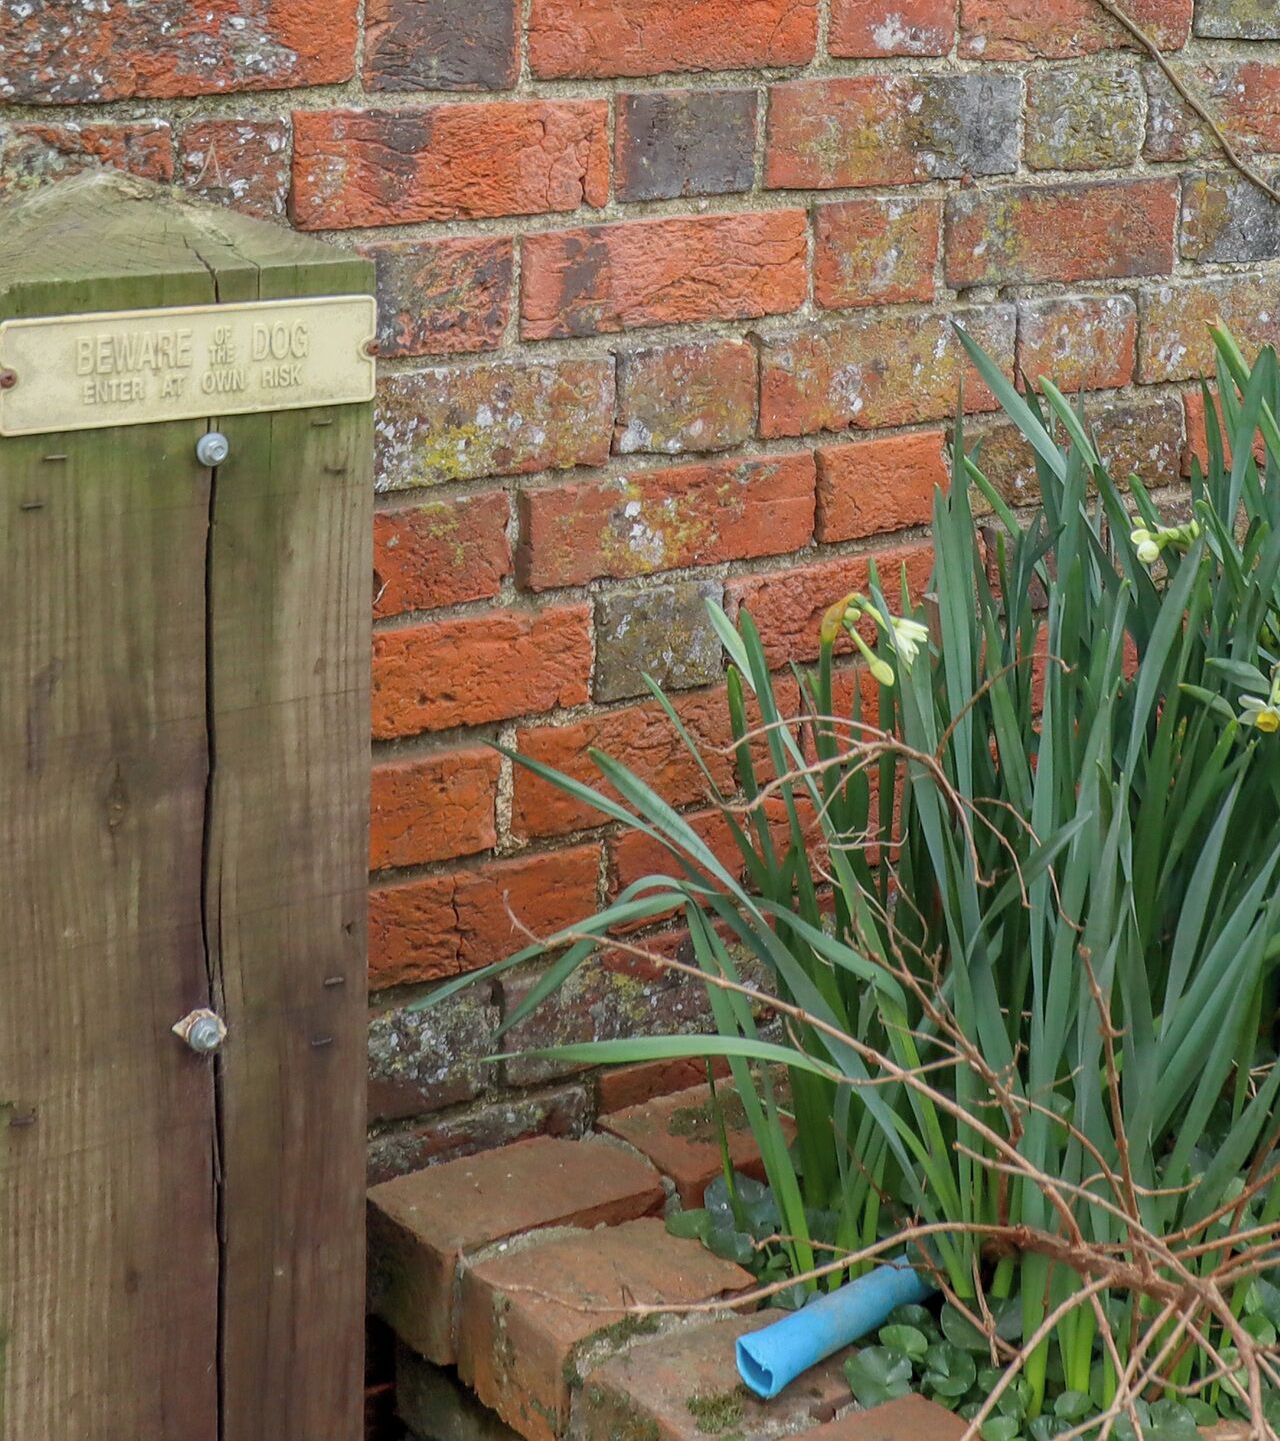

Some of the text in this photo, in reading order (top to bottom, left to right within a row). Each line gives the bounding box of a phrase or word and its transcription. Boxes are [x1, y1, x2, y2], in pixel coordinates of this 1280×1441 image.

[76, 318, 309, 376] BEWARE OF THE DOG
[83, 363, 303, 405] ENTER AT OWN RISK
